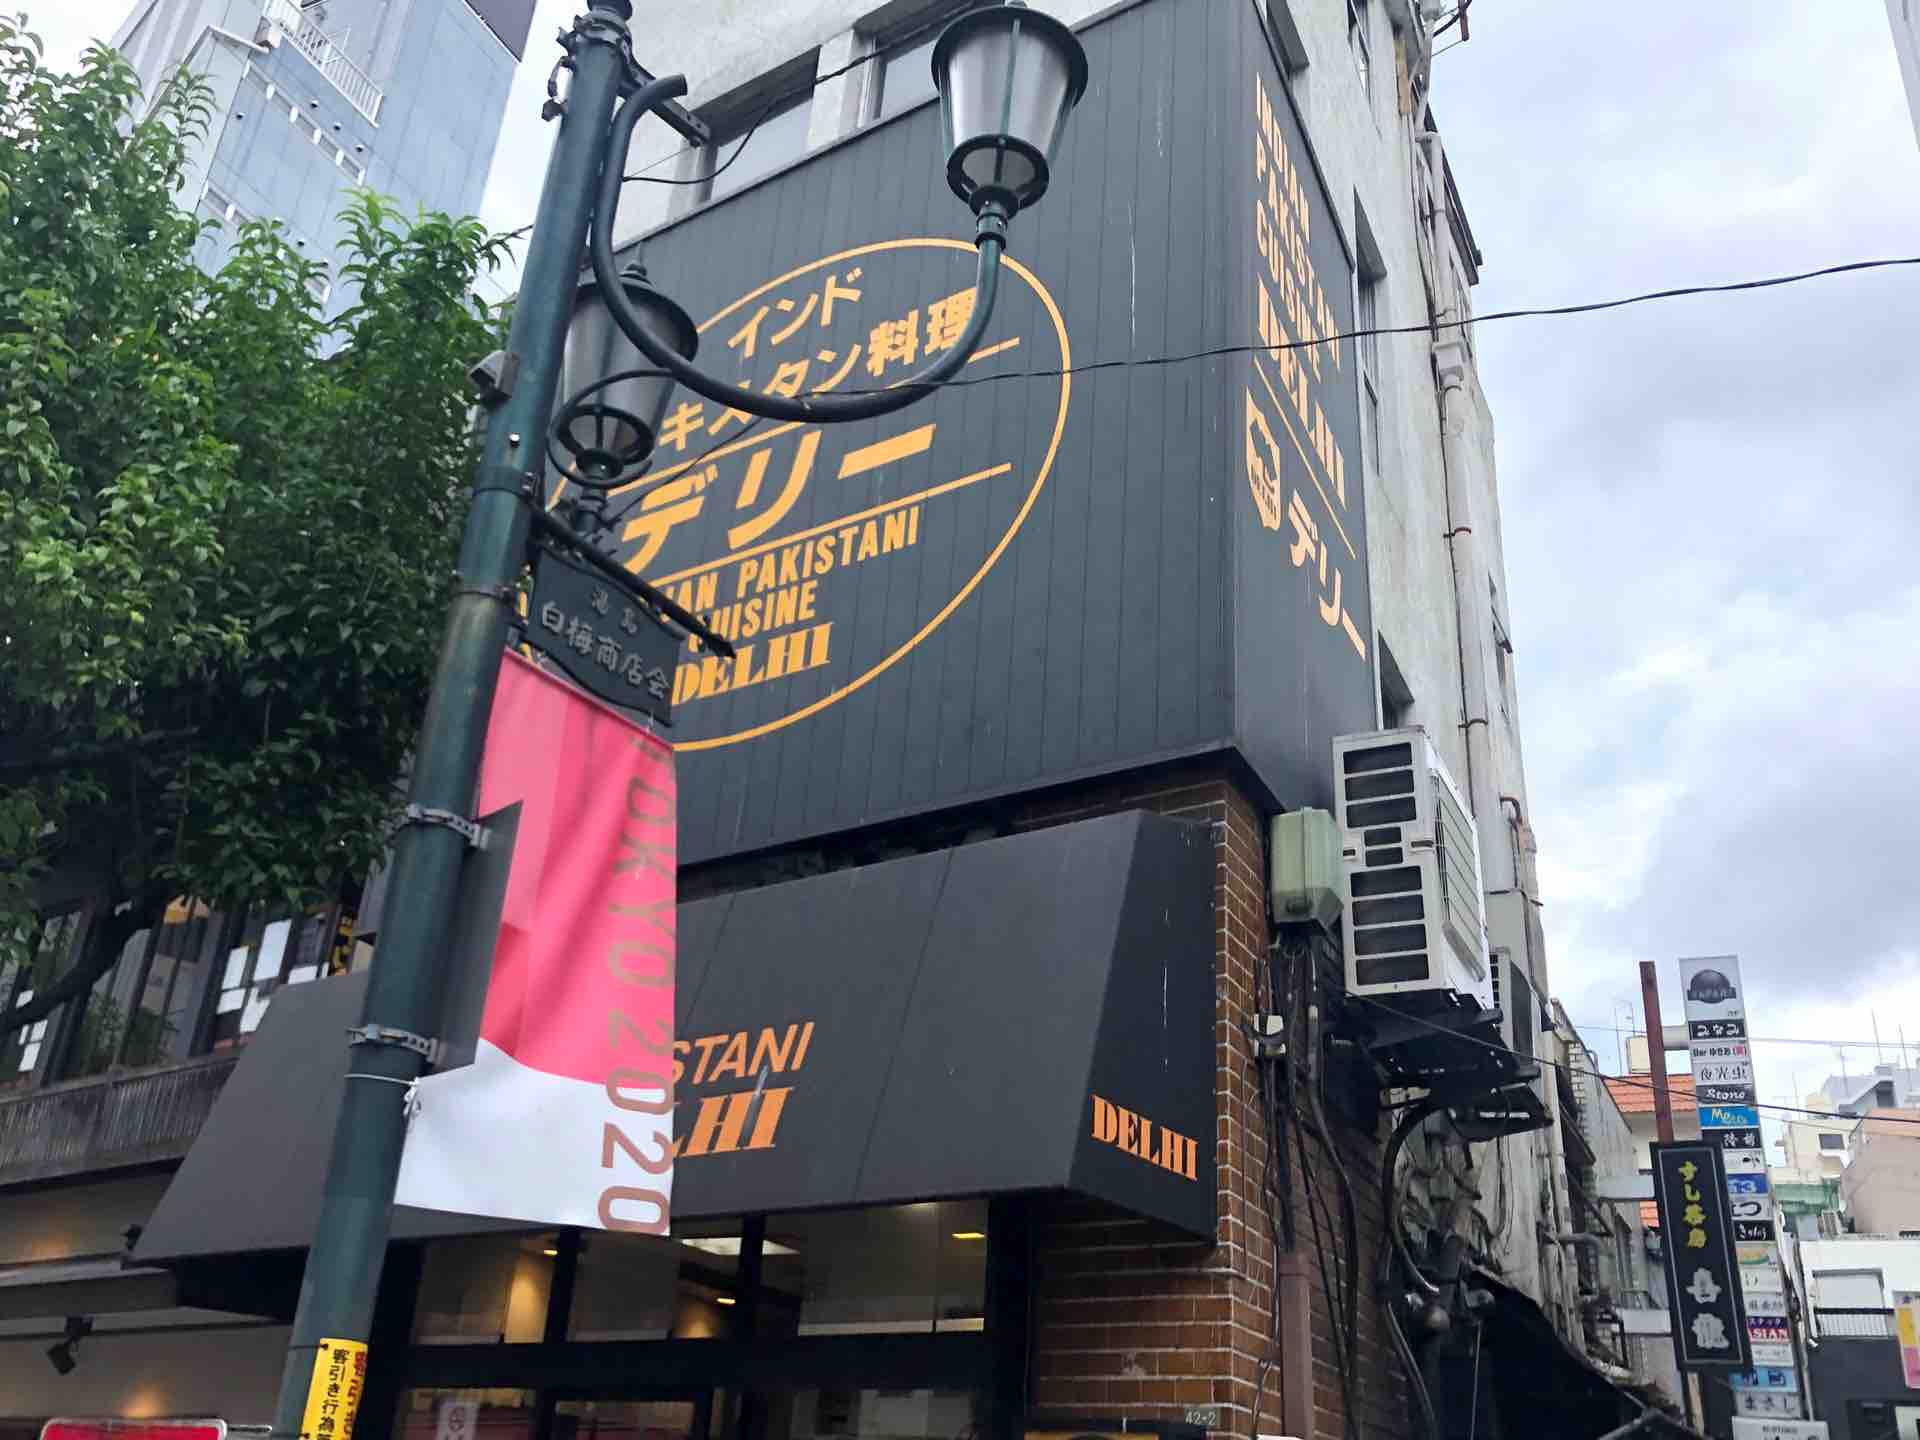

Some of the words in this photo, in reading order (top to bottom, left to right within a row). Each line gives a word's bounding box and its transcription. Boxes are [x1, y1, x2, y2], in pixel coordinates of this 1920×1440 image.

[727, 267, 863, 359] インド
[1256, 272, 1347, 512] DELHI
[620, 423, 937, 576] デリー
[736, 506, 921, 600] PAKISTANI
[1287, 487, 1367, 662] デリー
[671, 621, 833, 706] DELHI
[598, 1008, 676, 1235] 2020
[1090, 1094, 1199, 1182] DELHI
